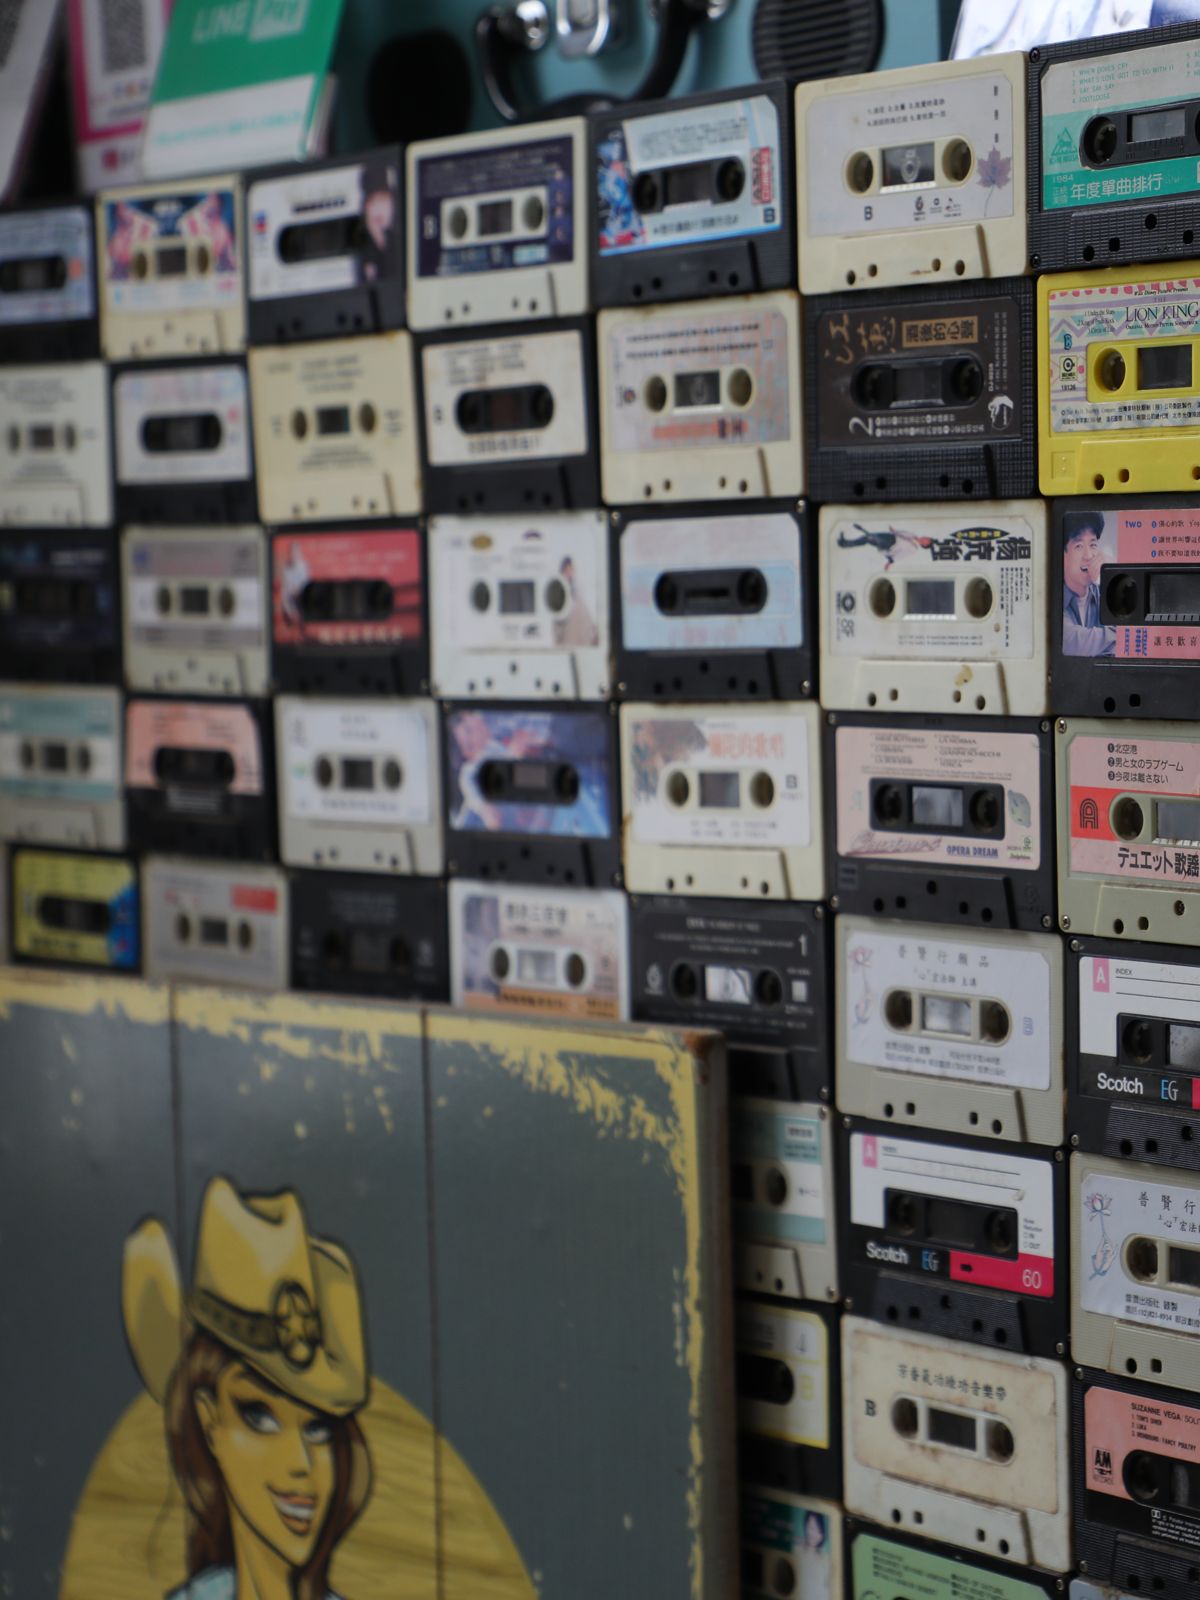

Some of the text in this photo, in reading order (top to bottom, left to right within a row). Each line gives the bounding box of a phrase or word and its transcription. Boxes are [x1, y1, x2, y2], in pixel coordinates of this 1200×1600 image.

[1071, 173, 1163, 200] 年度單曲排行
[864, 205, 873, 221] B
[1125, 301, 1199, 322] LION KING
[1063, 333, 1073, 350] B
[1125, 520, 1142, 529] two
[1080, 798, 1098, 829] A
[946, 845, 999, 859] OPERA DREAM
[1095, 966, 1107, 984] A
[1115, 967, 1133, 976] INDEX
[1097, 1072, 1144, 1095] Scotch
[1161, 1078, 1180, 1101] EG
[866, 1240, 1041, 1289] Scotch EG 60
[864, 1399, 877, 1417] B
[1131, 1402, 1161, 1416] SUZANNE
[1163, 1410, 1181, 1421] VEGA
